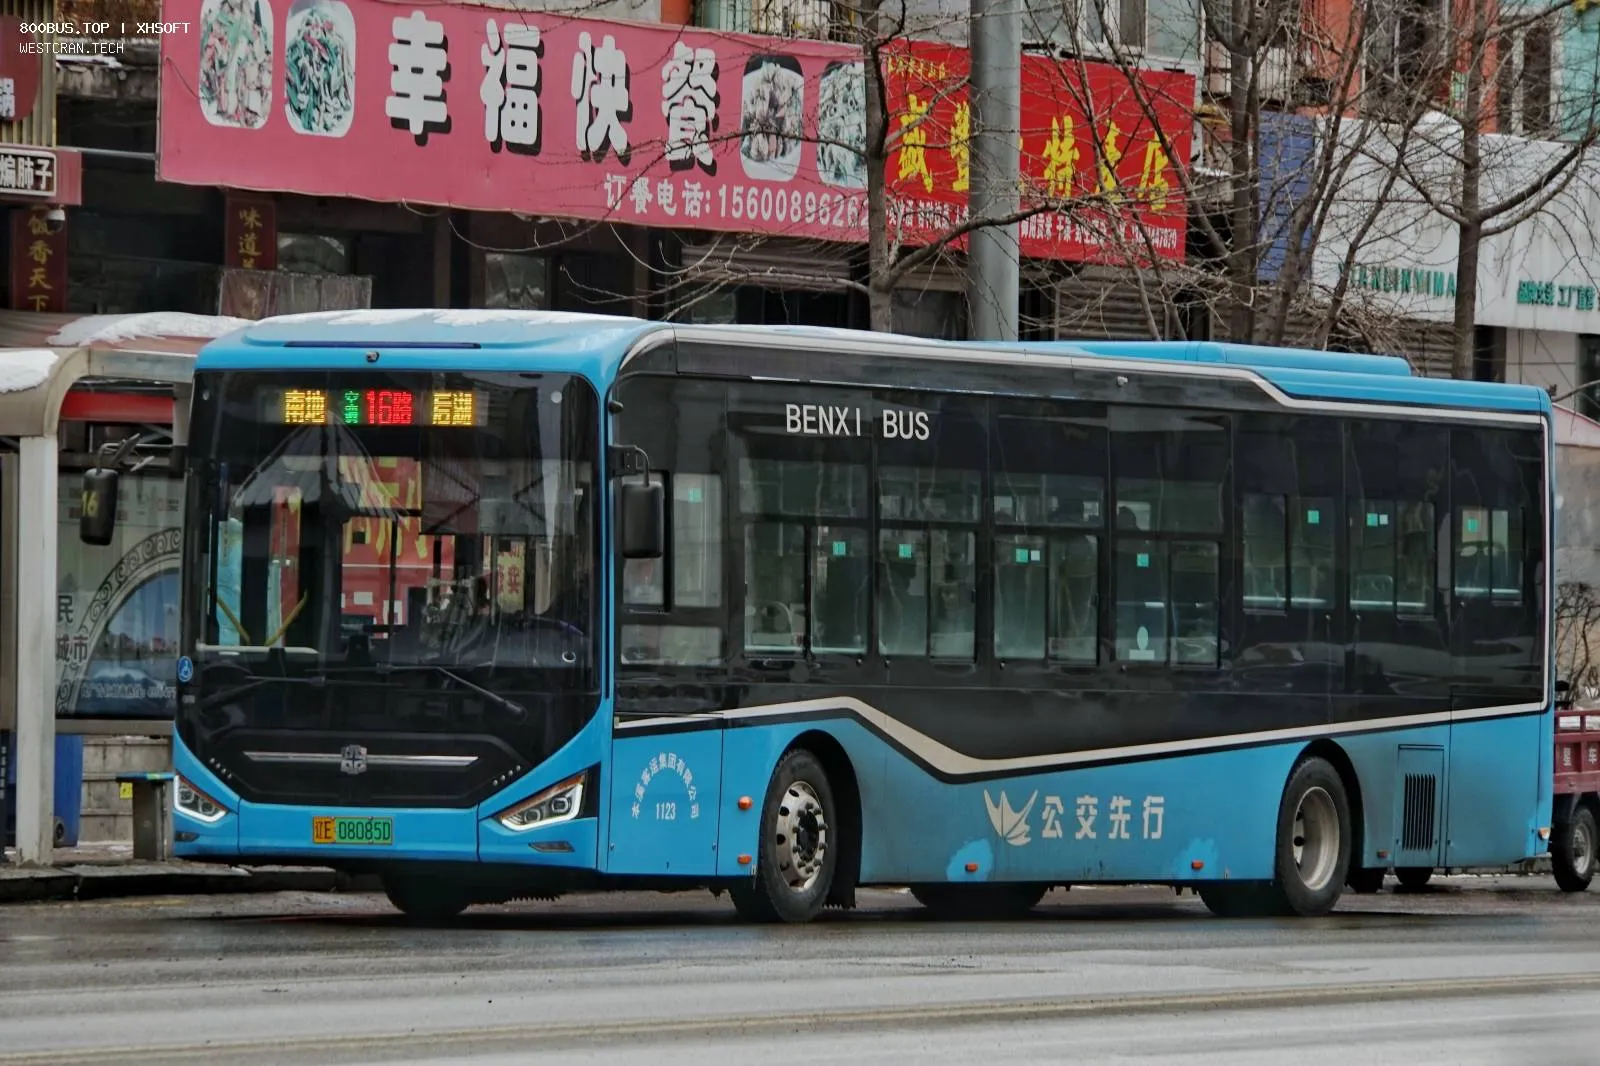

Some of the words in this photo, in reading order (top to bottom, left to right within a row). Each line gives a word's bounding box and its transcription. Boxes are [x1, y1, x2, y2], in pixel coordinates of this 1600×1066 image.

[385, 10, 718, 170] 幸福快餐
[285, 390, 325, 423] 南地
[366, 390, 413, 424] 16路
[785, 403, 861, 437] BENXI
[882, 408, 930, 441] BUS
[655, 801, 677, 821] 1123
[1041, 794, 1165, 840] 公交先行
